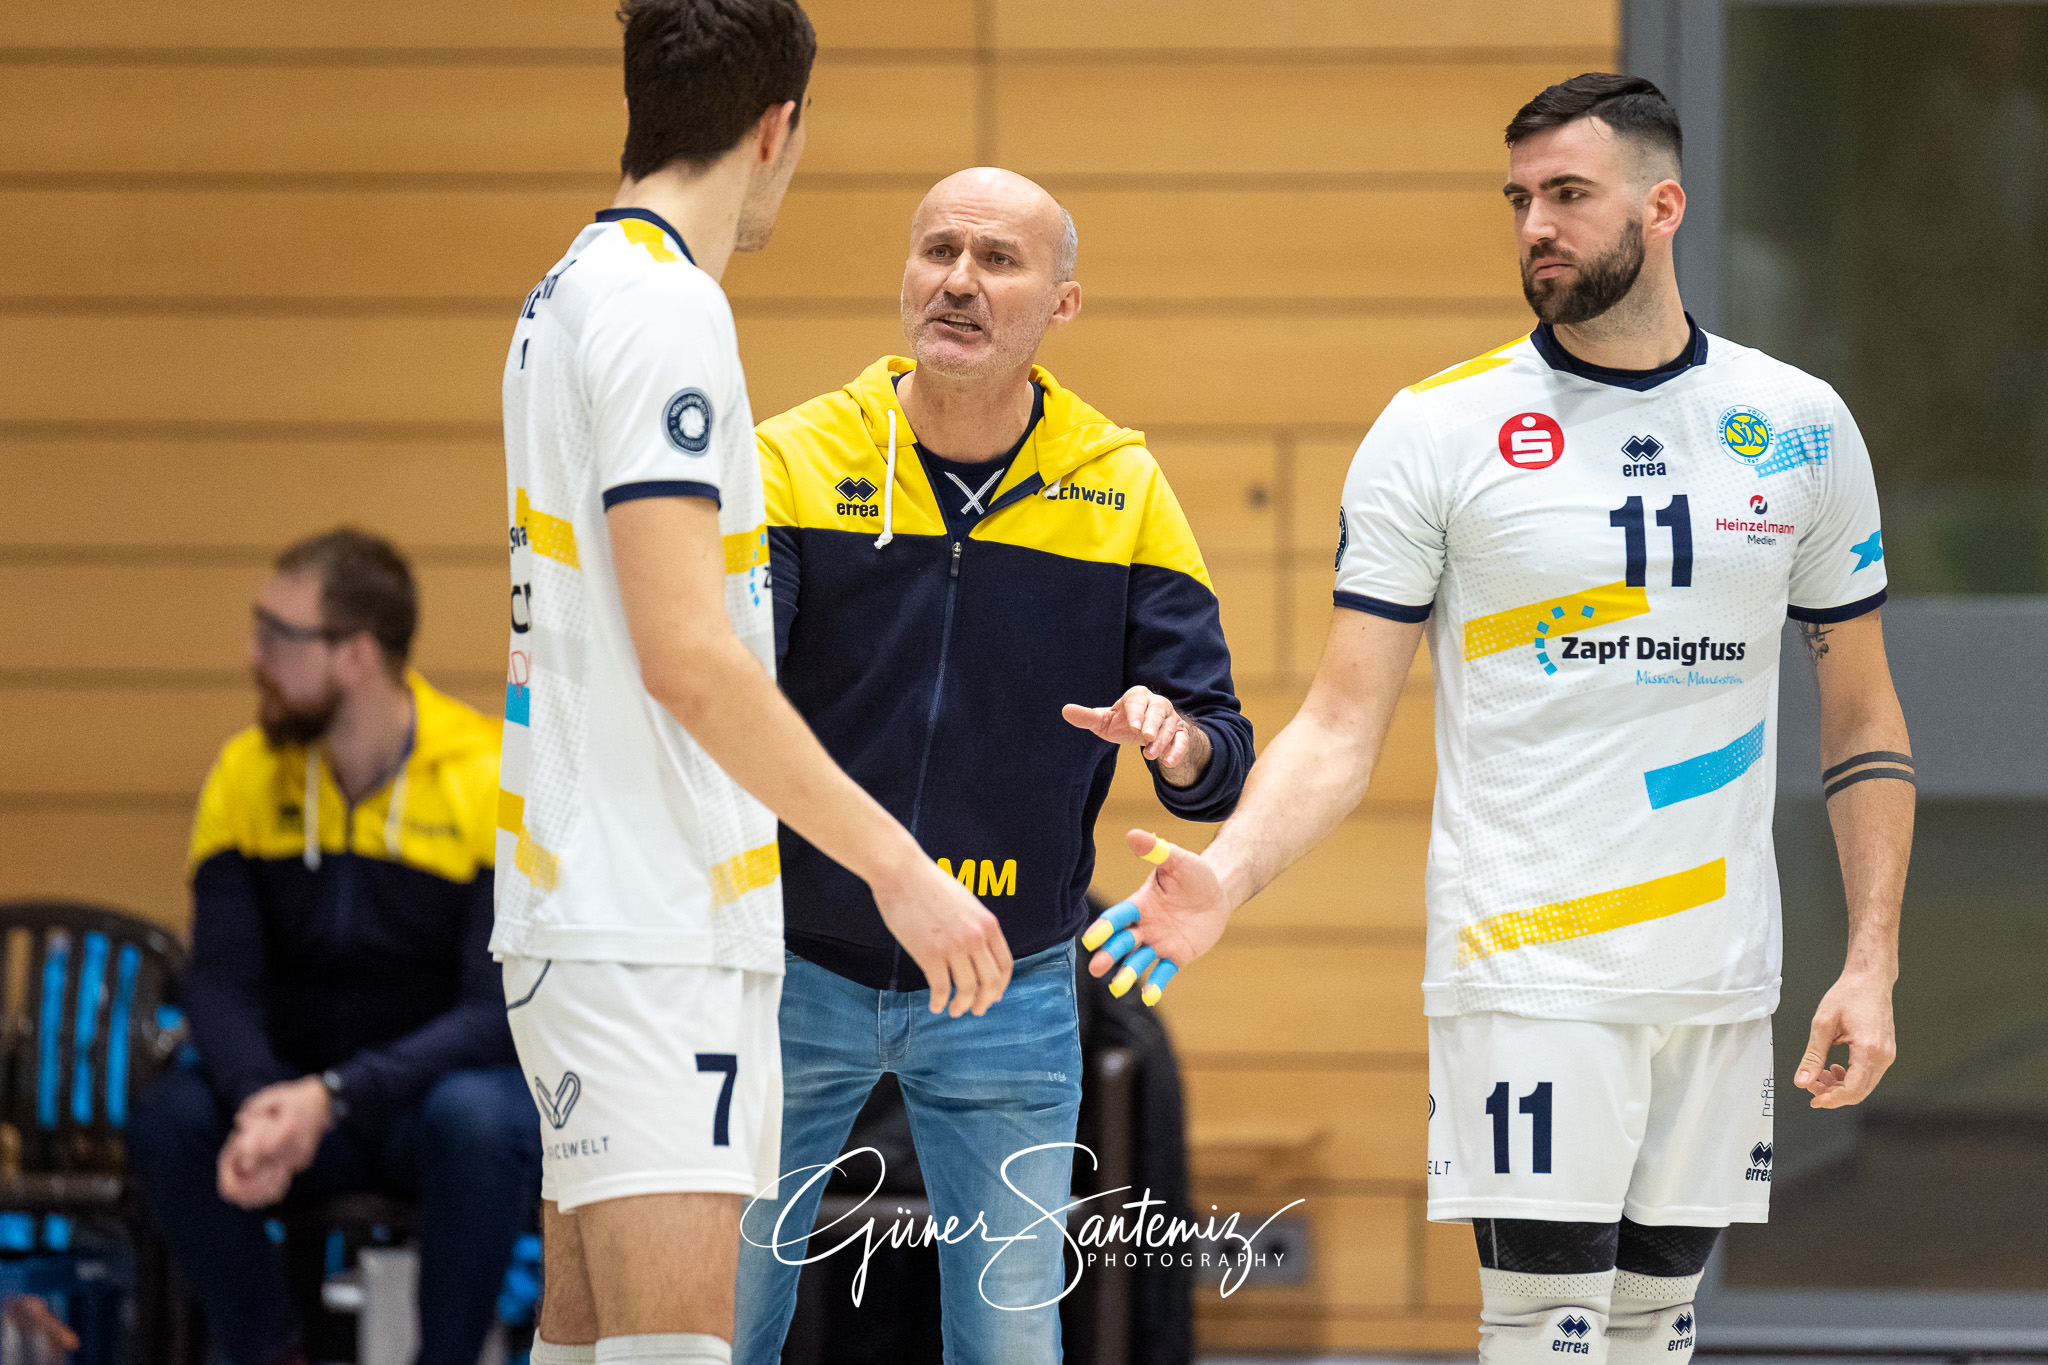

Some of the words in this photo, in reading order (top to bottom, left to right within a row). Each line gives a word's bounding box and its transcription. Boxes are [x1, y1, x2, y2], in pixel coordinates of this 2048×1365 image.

[1610, 494, 1694, 587] 11
[1716, 518, 1795, 535] Heinzelmann
[1748, 535, 1776, 546] Medien
[1561, 636, 1630, 665] Zapf
[1636, 636, 1746, 666] Daigfuss
[695, 1053, 738, 1147] 7
[1486, 1082, 1552, 1174] 11
